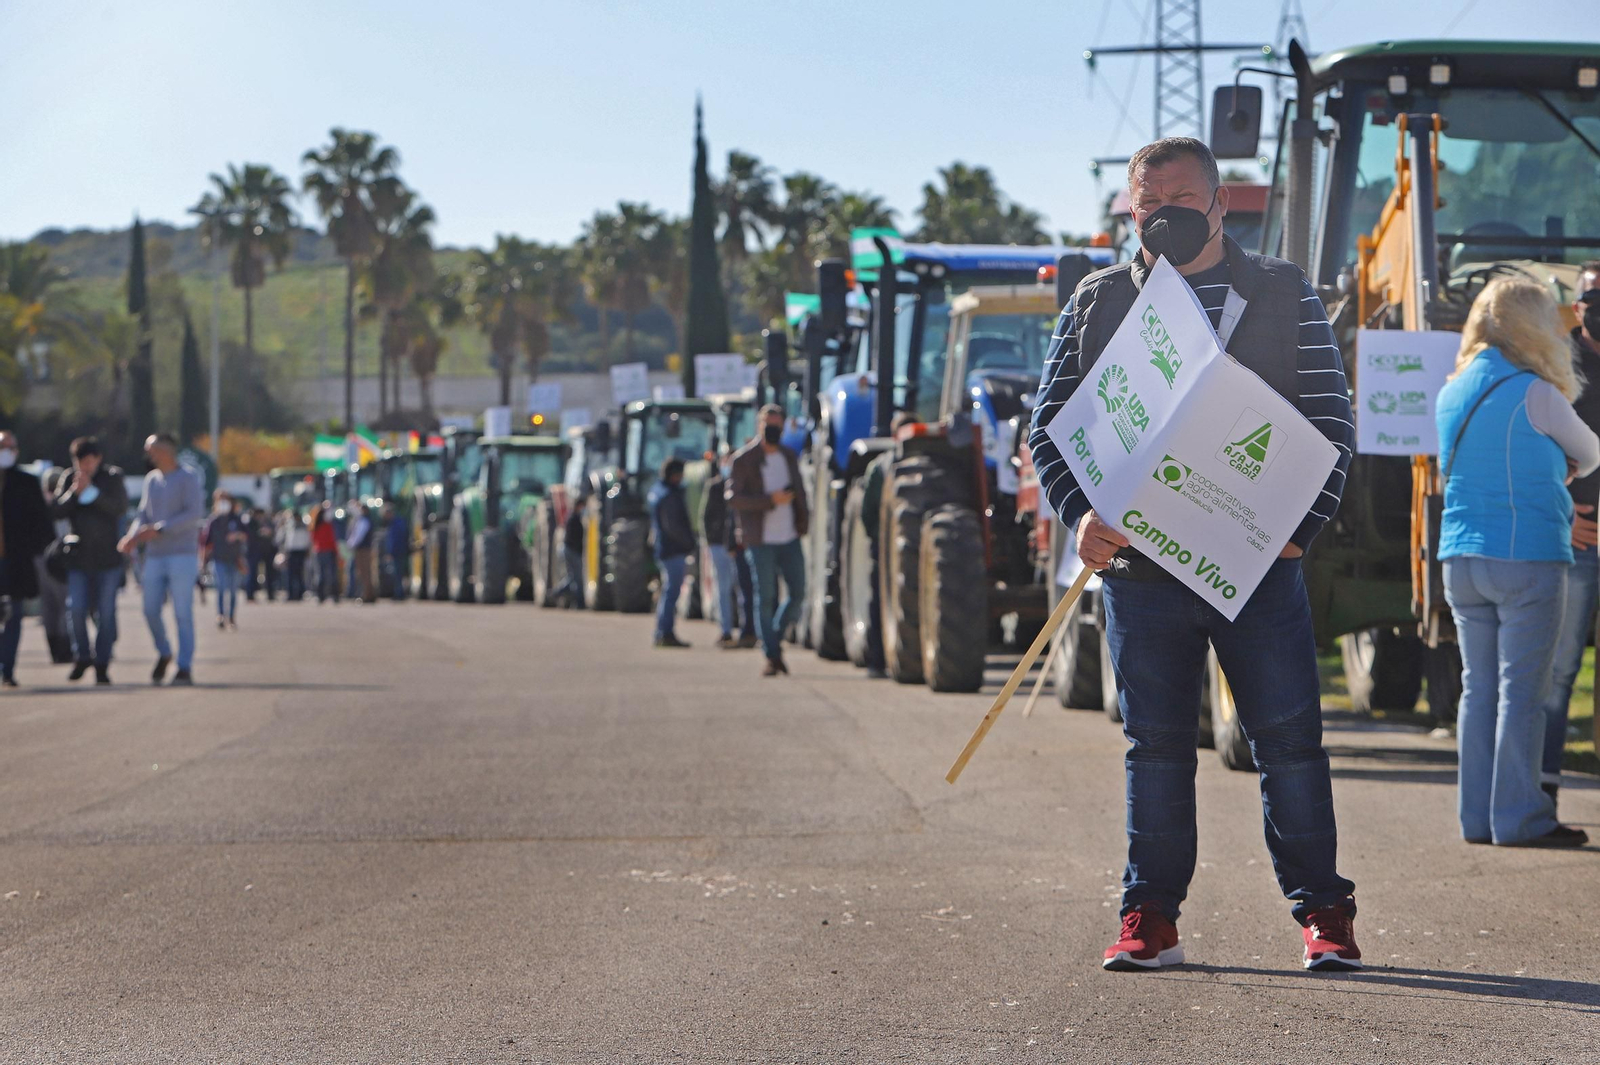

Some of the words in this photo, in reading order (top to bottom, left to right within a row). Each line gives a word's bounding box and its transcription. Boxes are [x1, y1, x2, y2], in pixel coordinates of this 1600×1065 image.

[1142, 304, 1182, 376] COAG
[1128, 392, 1150, 432] UPA
[1069, 426, 1091, 462] Por
[1085, 459, 1104, 487] un
[1223, 445, 1262, 475] ASAJA
[1376, 431, 1399, 445] Por
[1402, 435, 1420, 446] un
[1229, 459, 1257, 481] CADIZ
[1186, 480, 1272, 544] agro-alimentarias
[1191, 472, 1257, 520] cooperativas
[1122, 509, 1192, 565] Campo
[1195, 555, 1237, 600] Vivo
